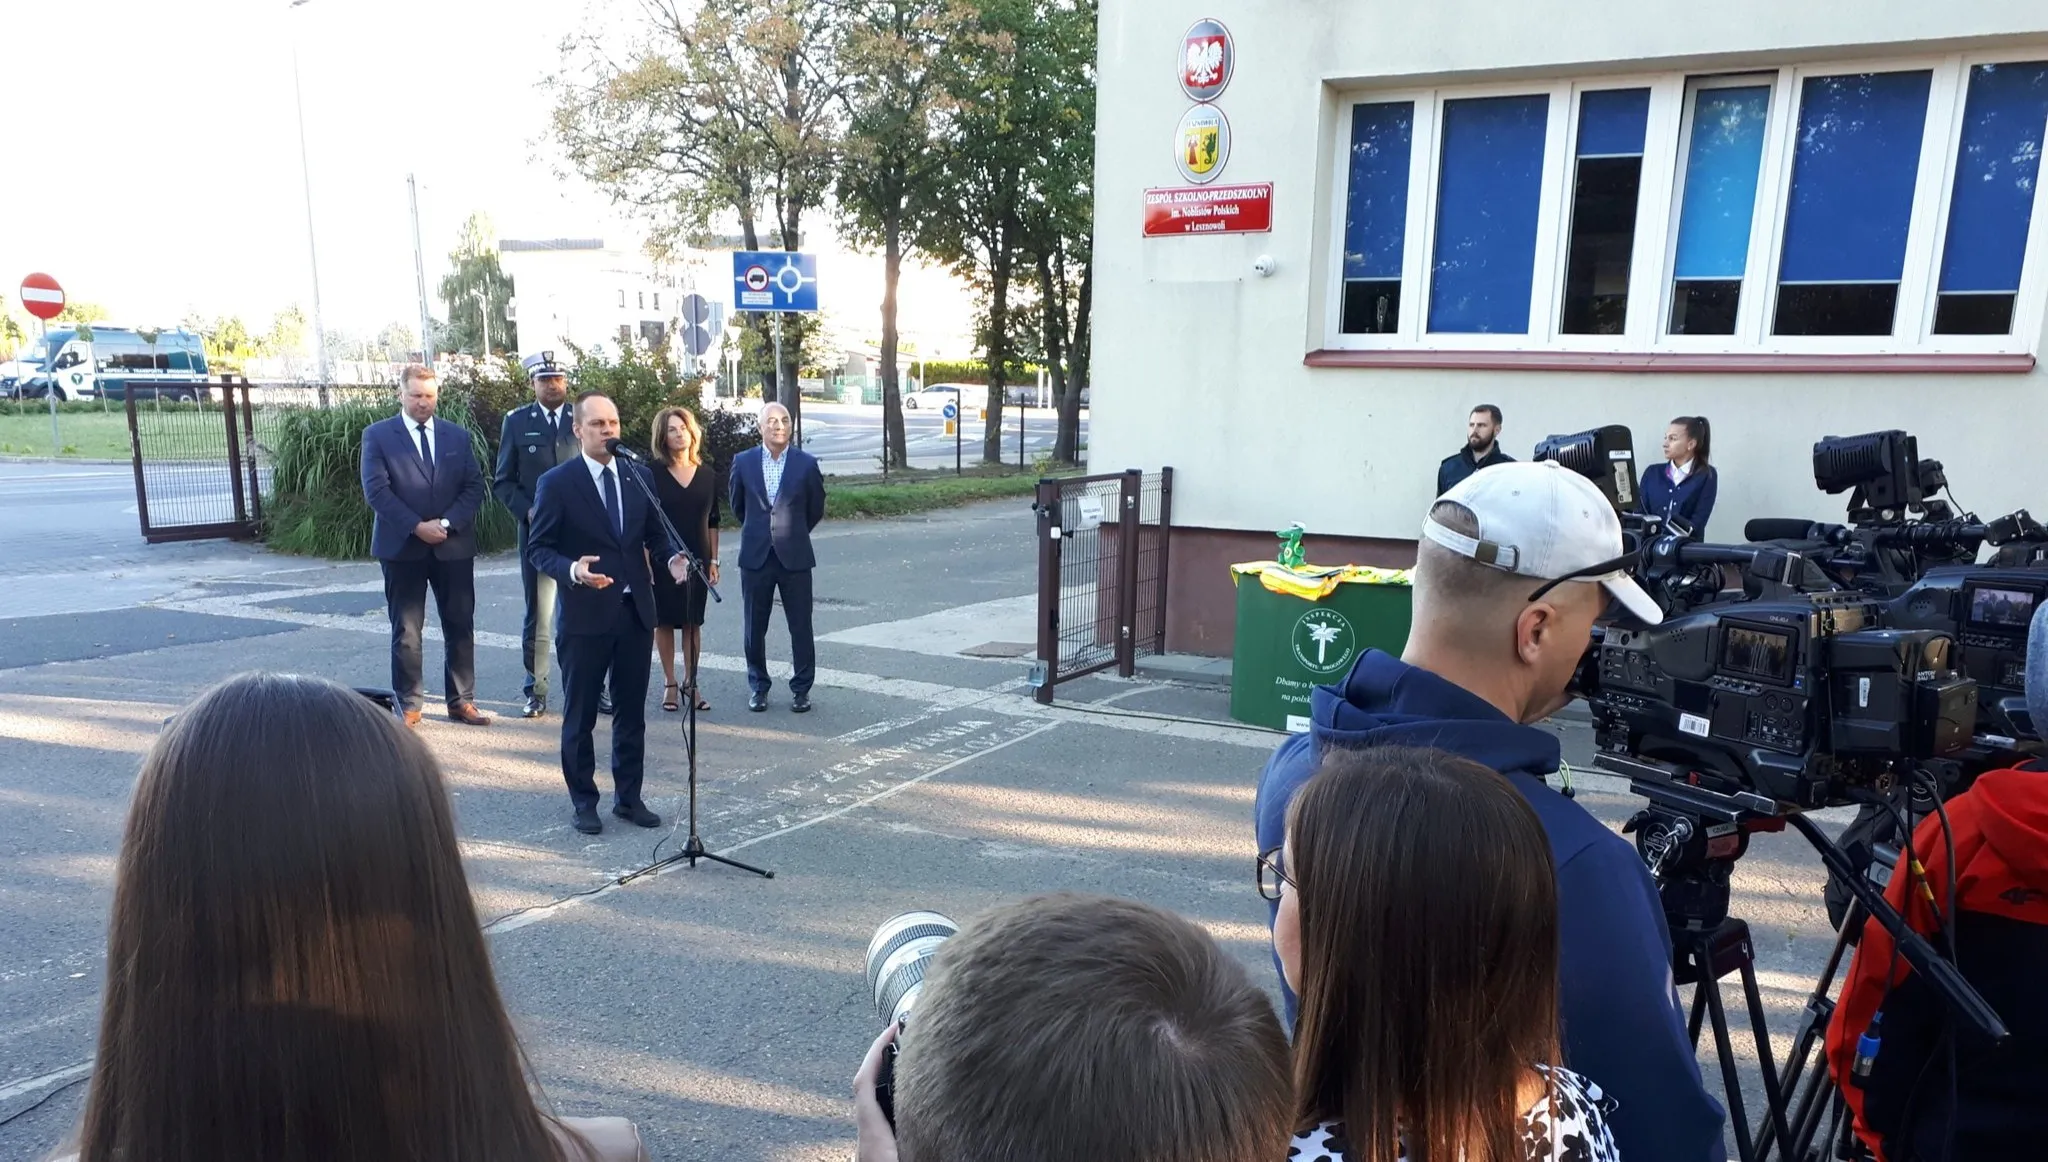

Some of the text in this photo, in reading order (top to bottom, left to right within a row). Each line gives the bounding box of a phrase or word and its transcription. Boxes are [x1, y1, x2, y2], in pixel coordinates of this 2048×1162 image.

[1147, 188, 1268, 204] ZESPÓŁ SZKOLNO-PRZEDSZKOLNY
[1171, 204, 1240, 218] im. Noblistów Polskich
[1192, 220, 1226, 231] Lesznowoli
[1302, 611, 1346, 628] INSPEKCJA
[1295, 644, 1351, 670] TRANSPORTU DROGOWEGO
[1275, 676, 1301, 689] Dbamy
[1281, 693, 1312, 704] na polsk
